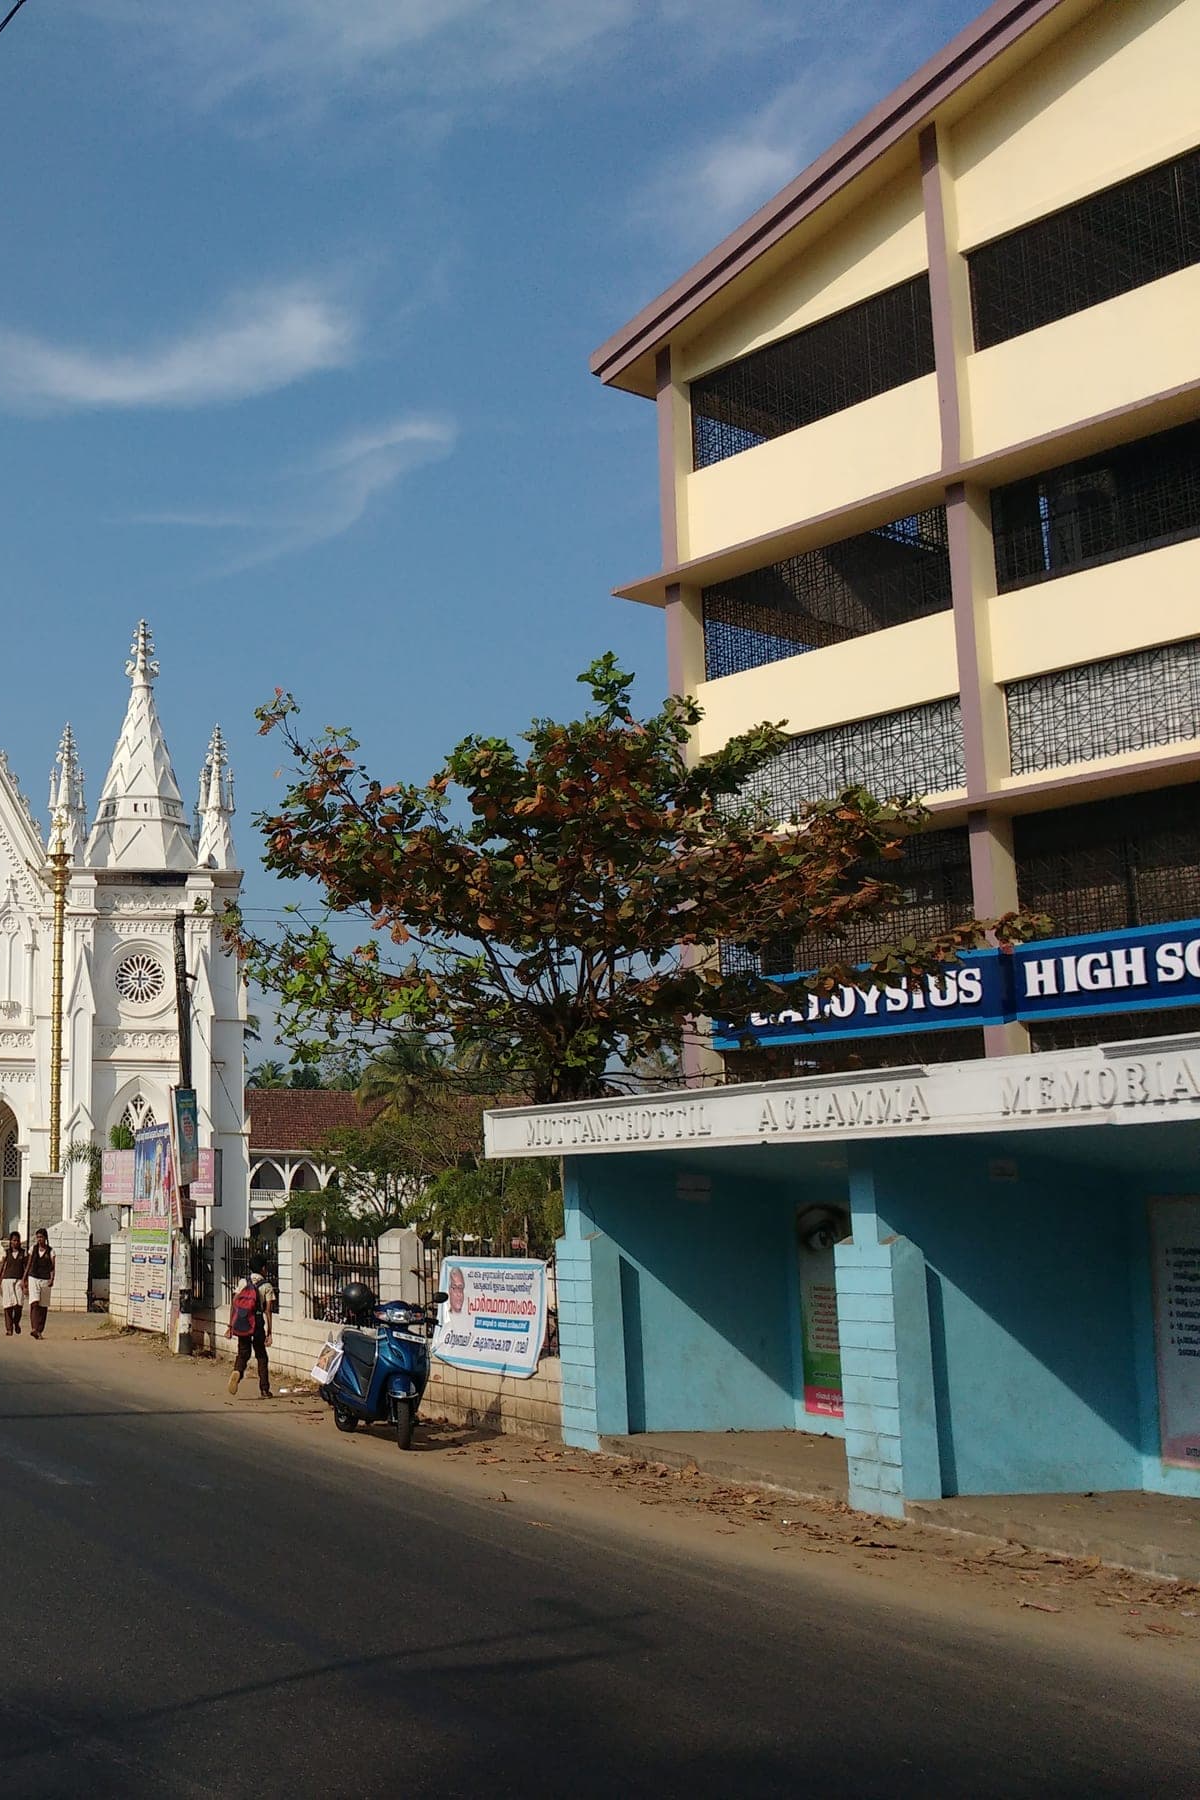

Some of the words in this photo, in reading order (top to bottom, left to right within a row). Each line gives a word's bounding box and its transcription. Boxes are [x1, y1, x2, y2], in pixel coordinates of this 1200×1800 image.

[1023, 946, 1148, 997] HIGH
[527, 1105, 711, 1147] MUTTANTHOTTIL
[758, 1083, 930, 1133] ACHAMMA
